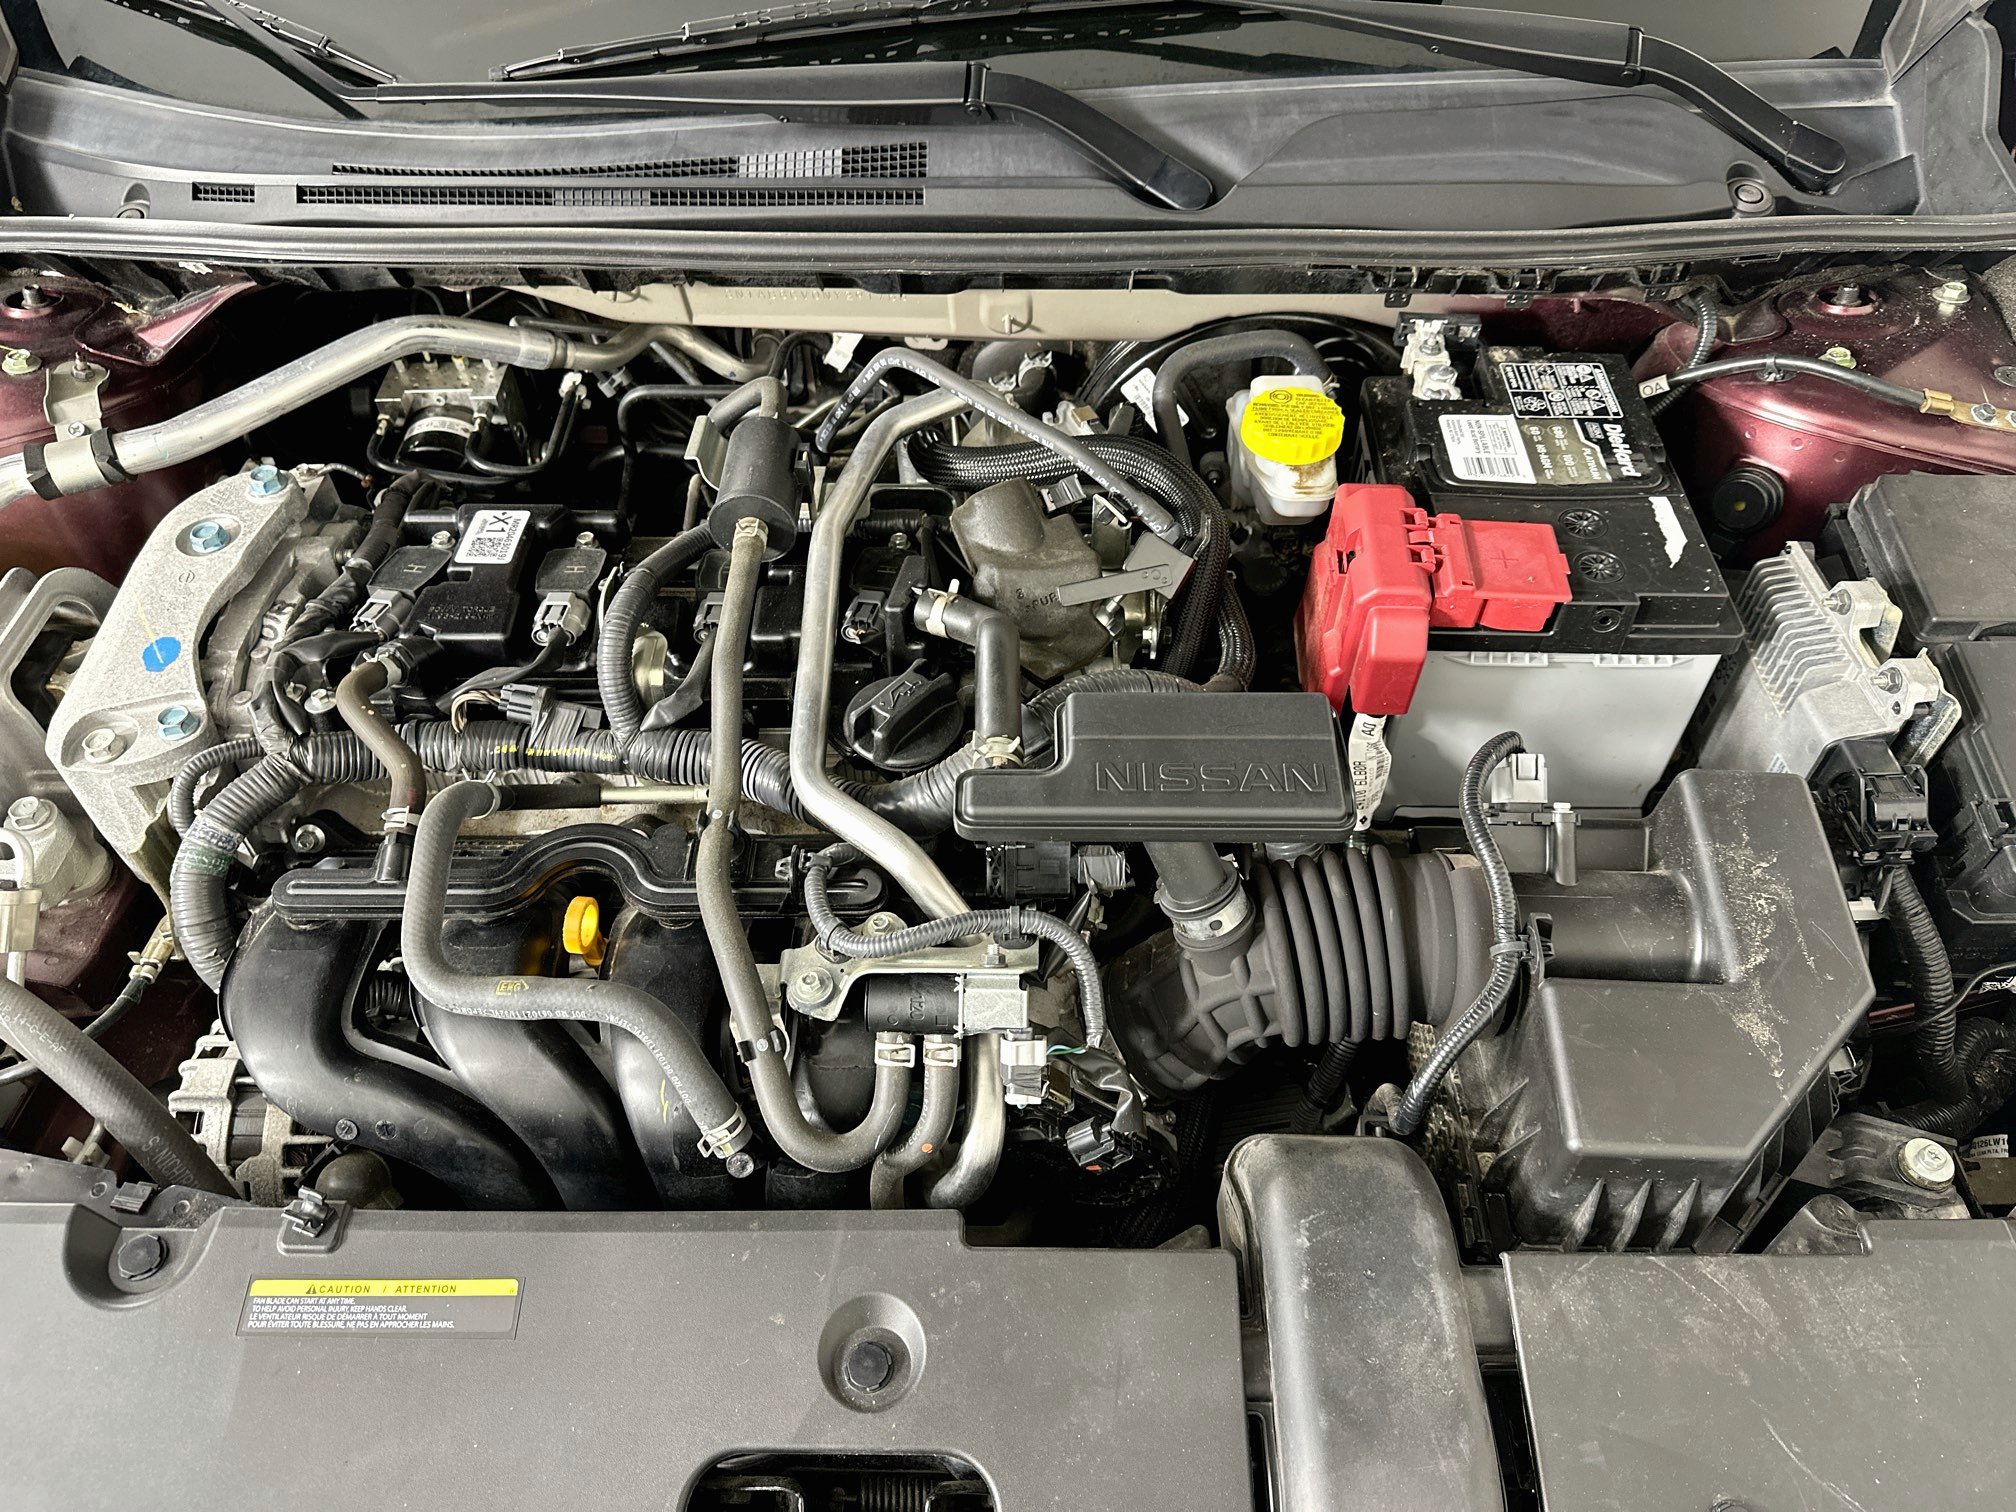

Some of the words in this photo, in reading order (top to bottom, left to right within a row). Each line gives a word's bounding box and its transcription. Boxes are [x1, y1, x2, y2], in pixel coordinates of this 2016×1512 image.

[1475, 420, 1490, 454] NON-SPILLABLE
[1603, 424, 1641, 477] DieHard
[1582, 448, 1602, 480] PLATINUM
[1095, 761, 1326, 793] NISSAN
[319, 1285, 371, 1293] CAUTION
[395, 1285, 457, 1293] ATTENTION
[247, 1321, 268, 1329] POUR
[268, 1321, 289, 1329] ÉVITER
[289, 1321, 312, 1329] TOUTE
[312, 1321, 346, 1329] BLESSURE,
[346, 1321, 357, 1329] NE
[356, 1321, 370, 1329] PAS
[369, 1321, 379, 1329] EN
[379, 1321, 419, 1329] APPROCHER
[419, 1321, 432, 1329] LES
[432, 1321, 456, 1329] MAINS.
